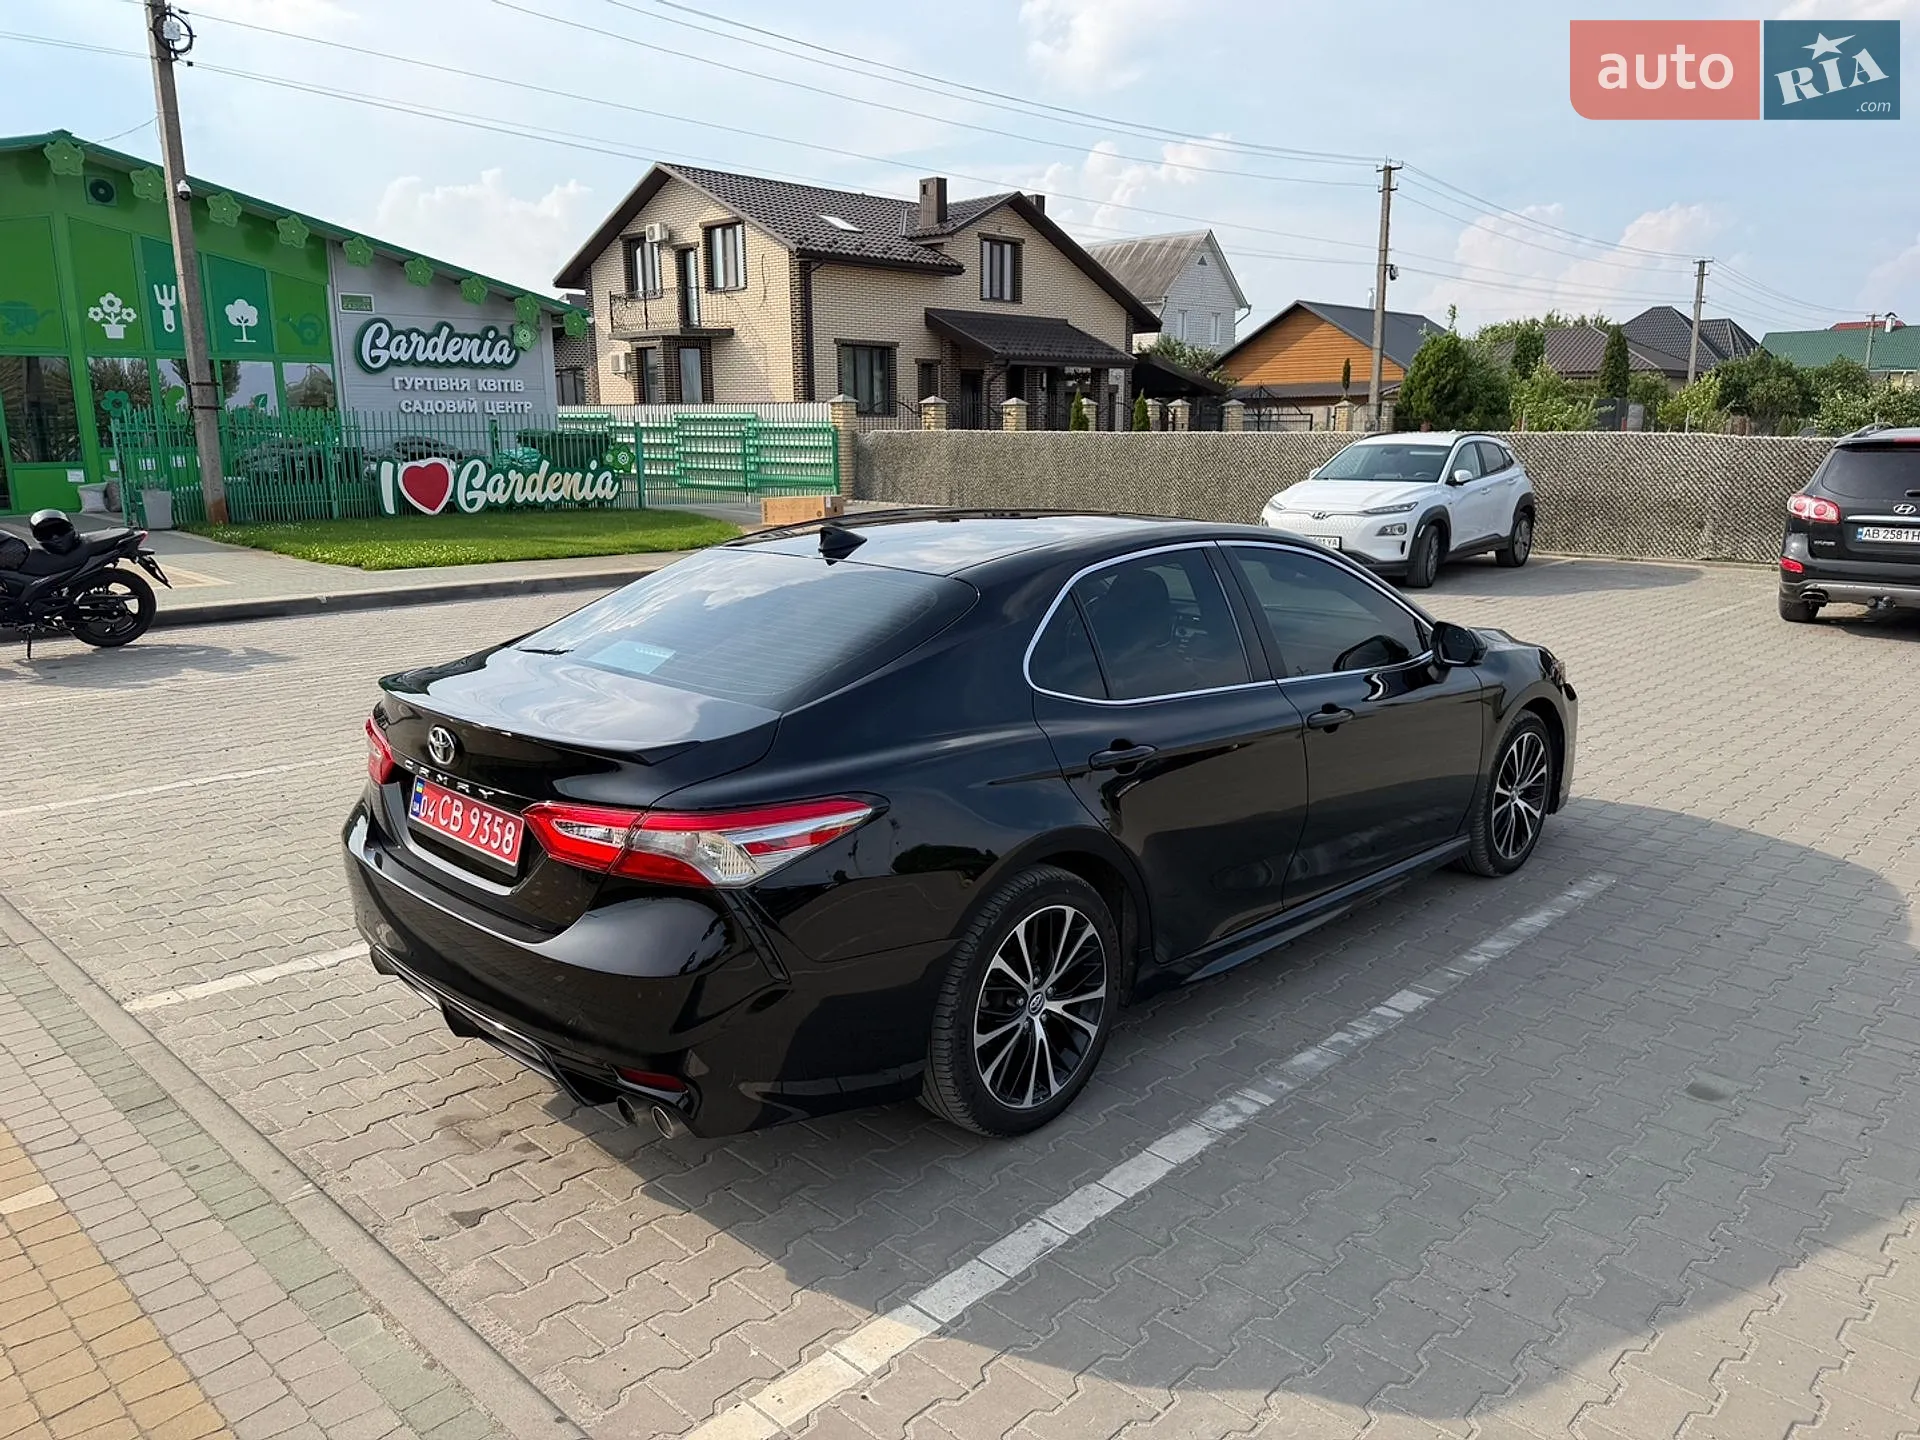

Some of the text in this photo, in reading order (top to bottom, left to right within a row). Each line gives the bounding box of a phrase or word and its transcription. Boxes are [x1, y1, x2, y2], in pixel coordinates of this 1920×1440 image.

[360, 321, 517, 370] Gardenia
[393, 376, 525, 392] ГУРТІВНЯ КВІТІВ
[400, 397, 533, 416] САДОВИЙ ЦЕНТР
[380, 458, 620, 515] I Gardenia
[1864, 529, 1881, 539] AB
[1882, 529, 1909, 541] 2581
[419, 794, 516, 855] 04 CB 9358
